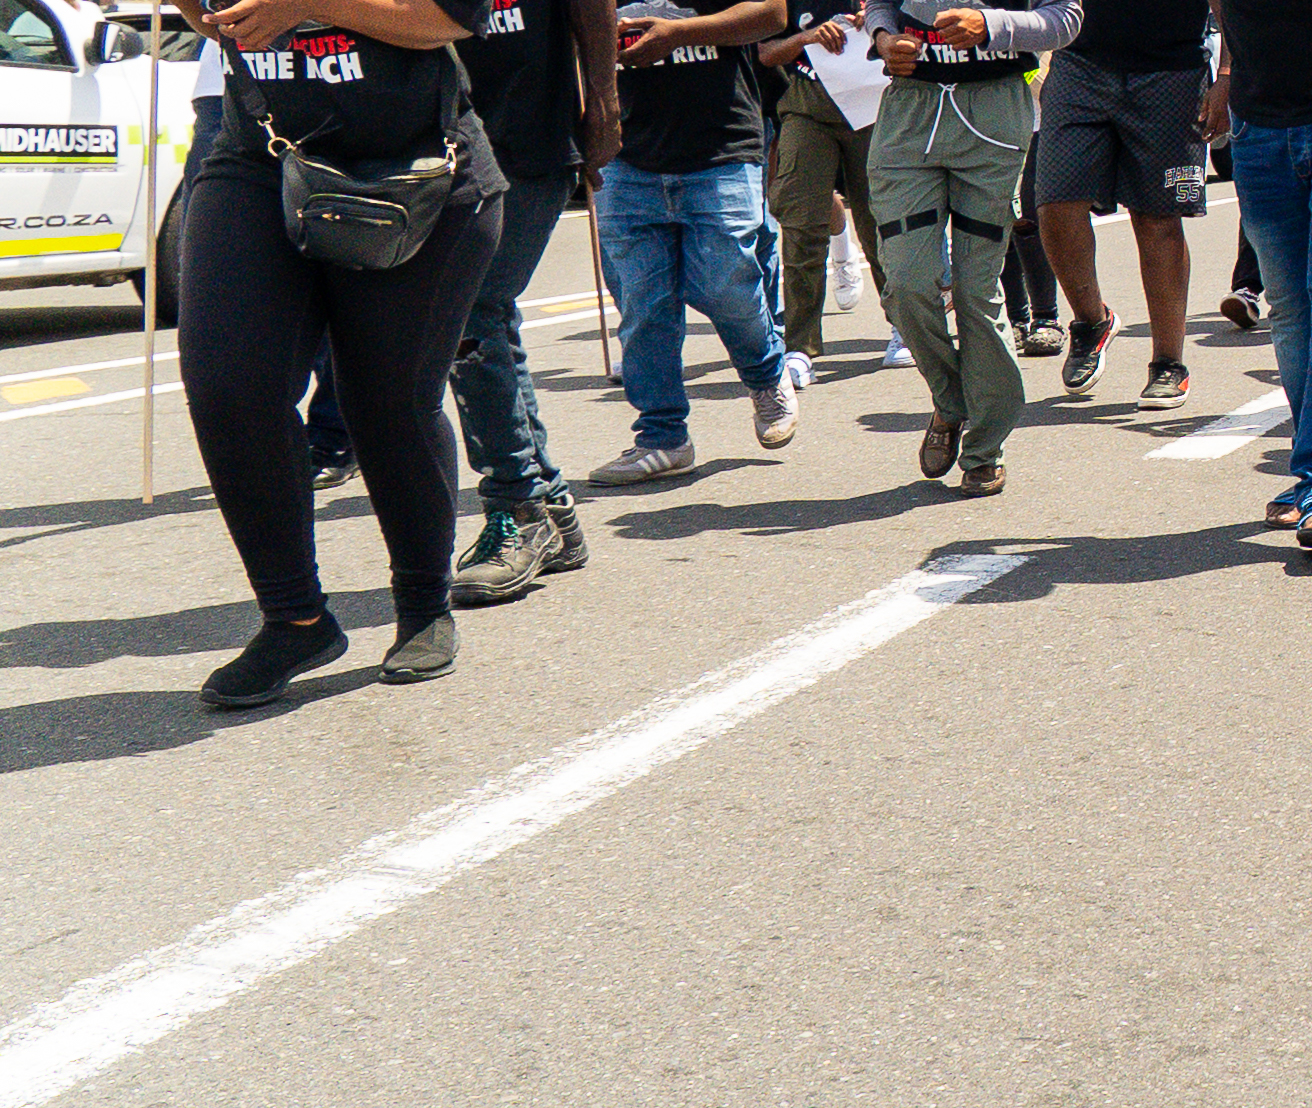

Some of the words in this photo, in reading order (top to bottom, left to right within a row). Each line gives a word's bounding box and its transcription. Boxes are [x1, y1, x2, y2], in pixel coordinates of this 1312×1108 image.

[673, 45, 719, 64] RICH
[931, 44, 970, 64] THE
[240, 51, 295, 80] THE
[1176, 182, 1200, 203] 55
